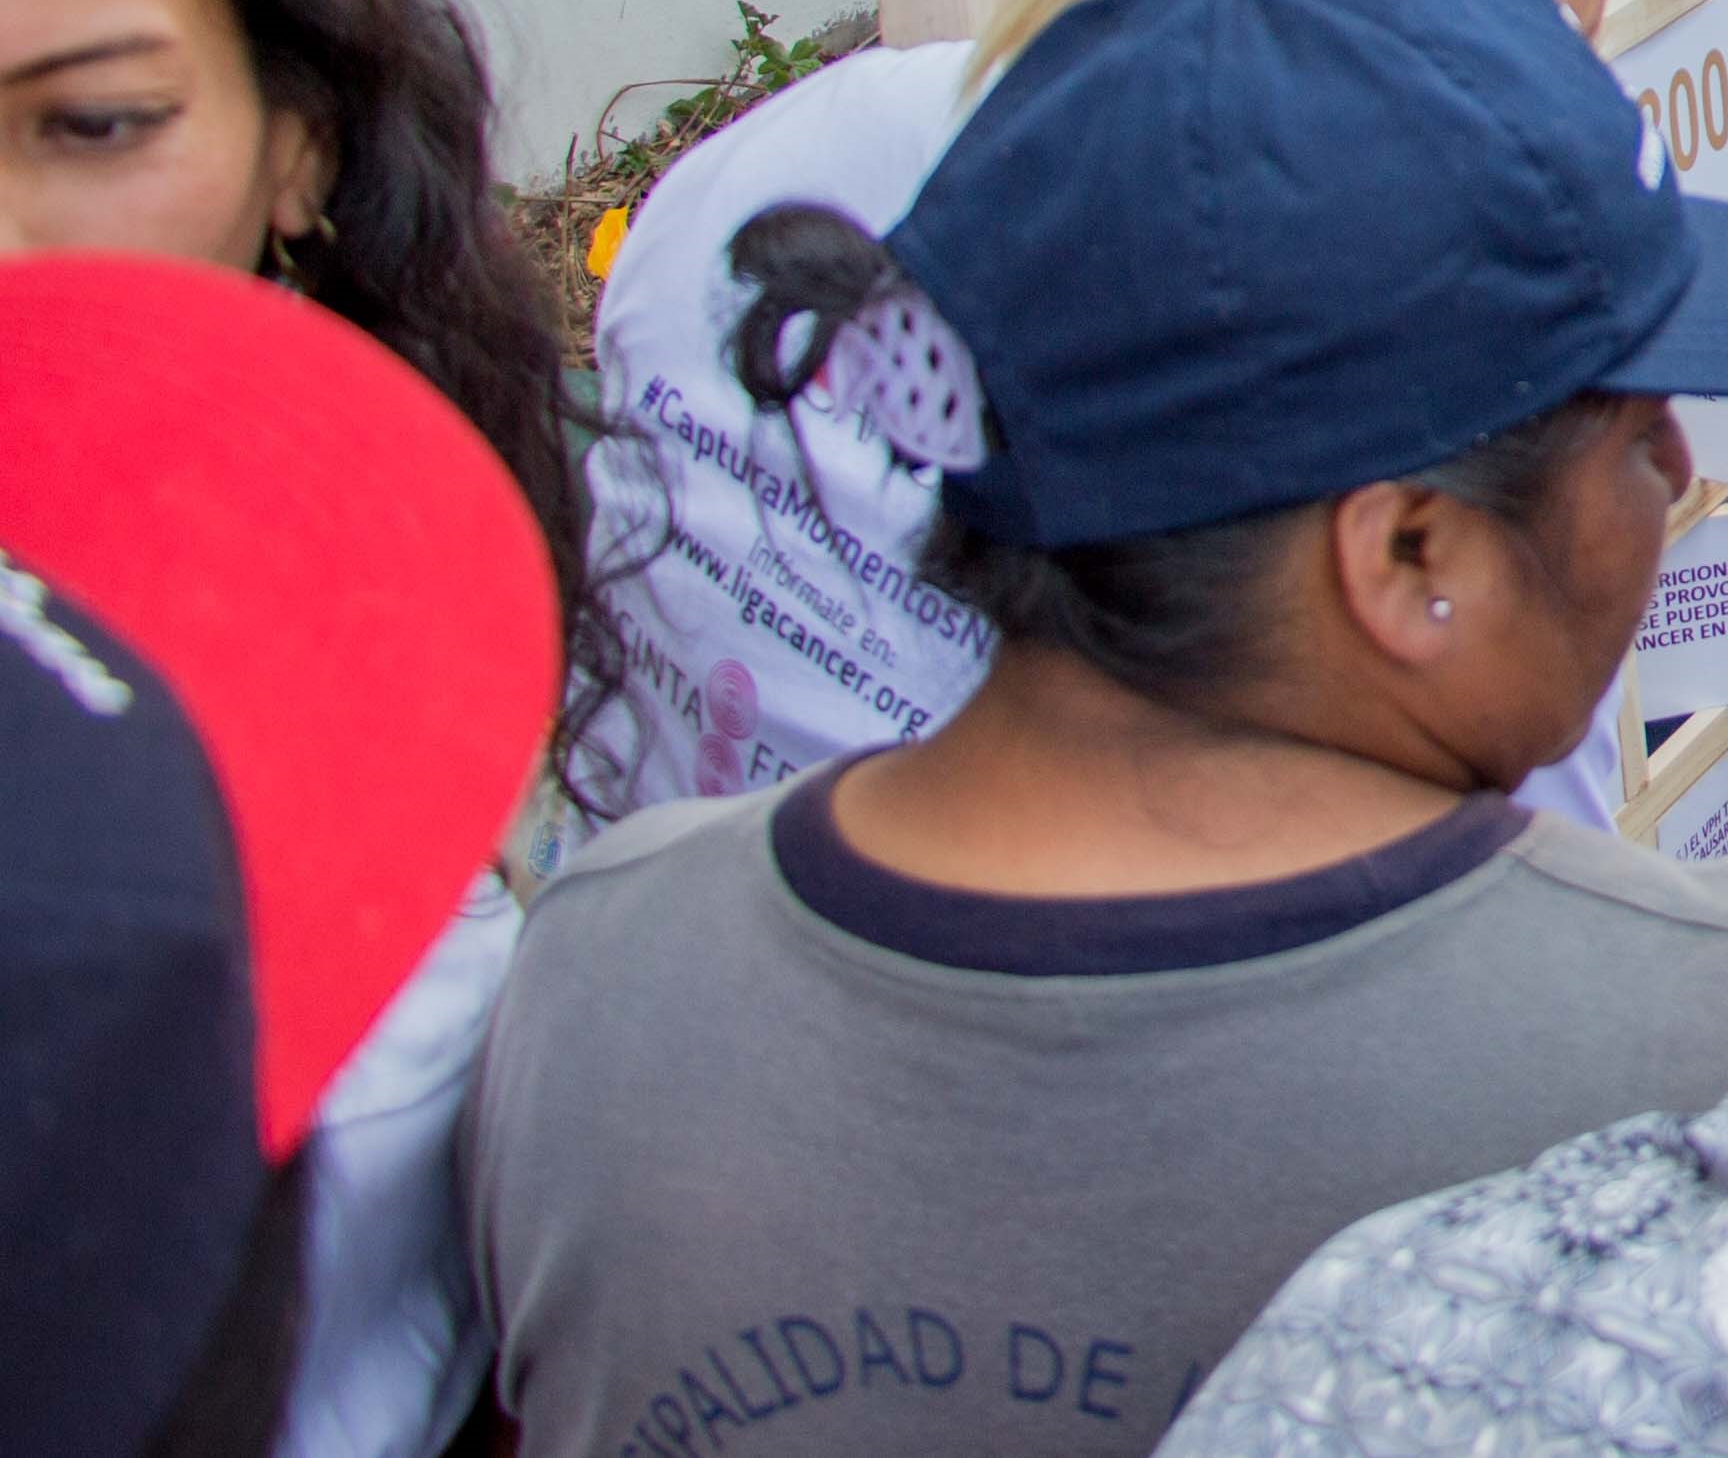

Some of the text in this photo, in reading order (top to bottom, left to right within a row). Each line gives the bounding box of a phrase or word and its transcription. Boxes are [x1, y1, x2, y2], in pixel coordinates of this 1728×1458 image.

[1699, 620, 1727, 640] EN
[1690, 832, 1701, 853] EL
[1701, 809, 1722, 839] VPH
[619, 1306, 964, 1458] IPALIDAD
[1009, 1320, 1134, 1422] DE
